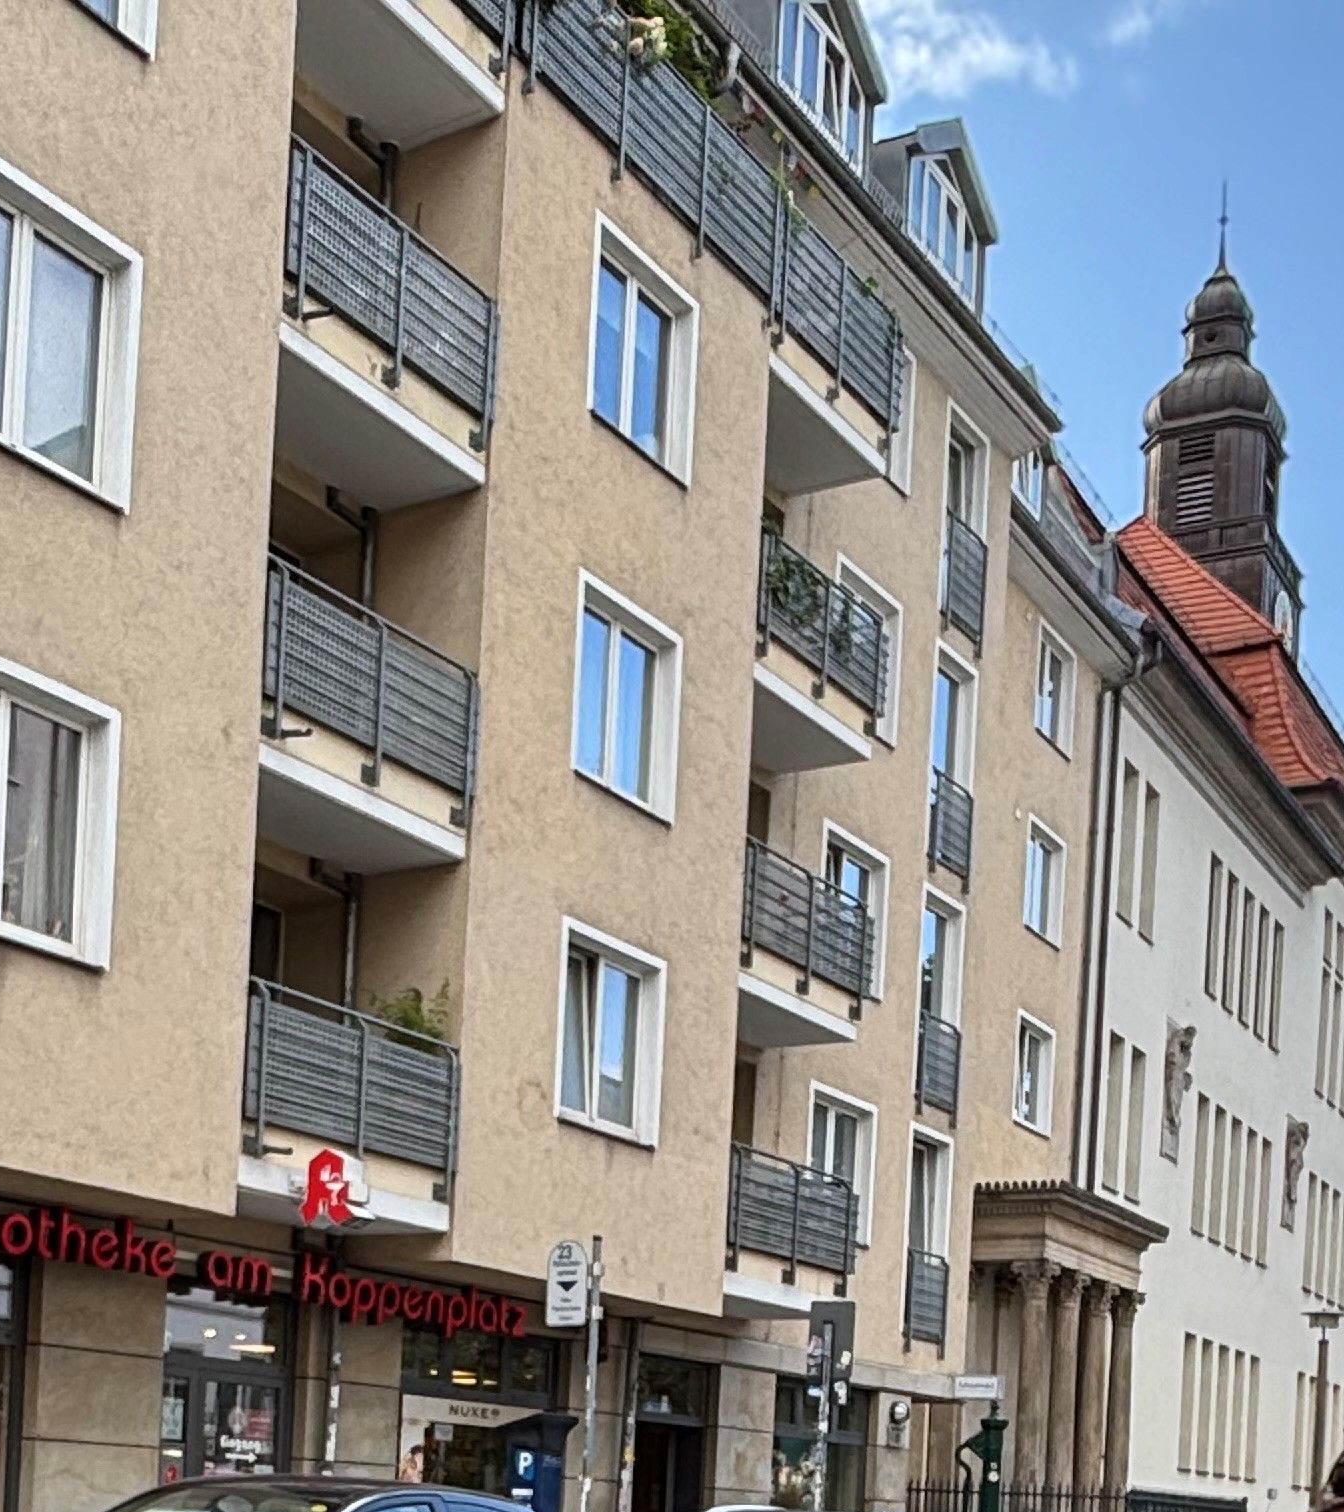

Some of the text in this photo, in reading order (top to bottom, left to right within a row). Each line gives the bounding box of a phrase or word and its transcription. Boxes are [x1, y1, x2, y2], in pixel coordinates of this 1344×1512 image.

[557, 1244, 573, 1260] 23
[207, 1249, 273, 1296] am
[300, 1252, 529, 1339] Koppenplatz
[518, 1451, 534, 1476] P
